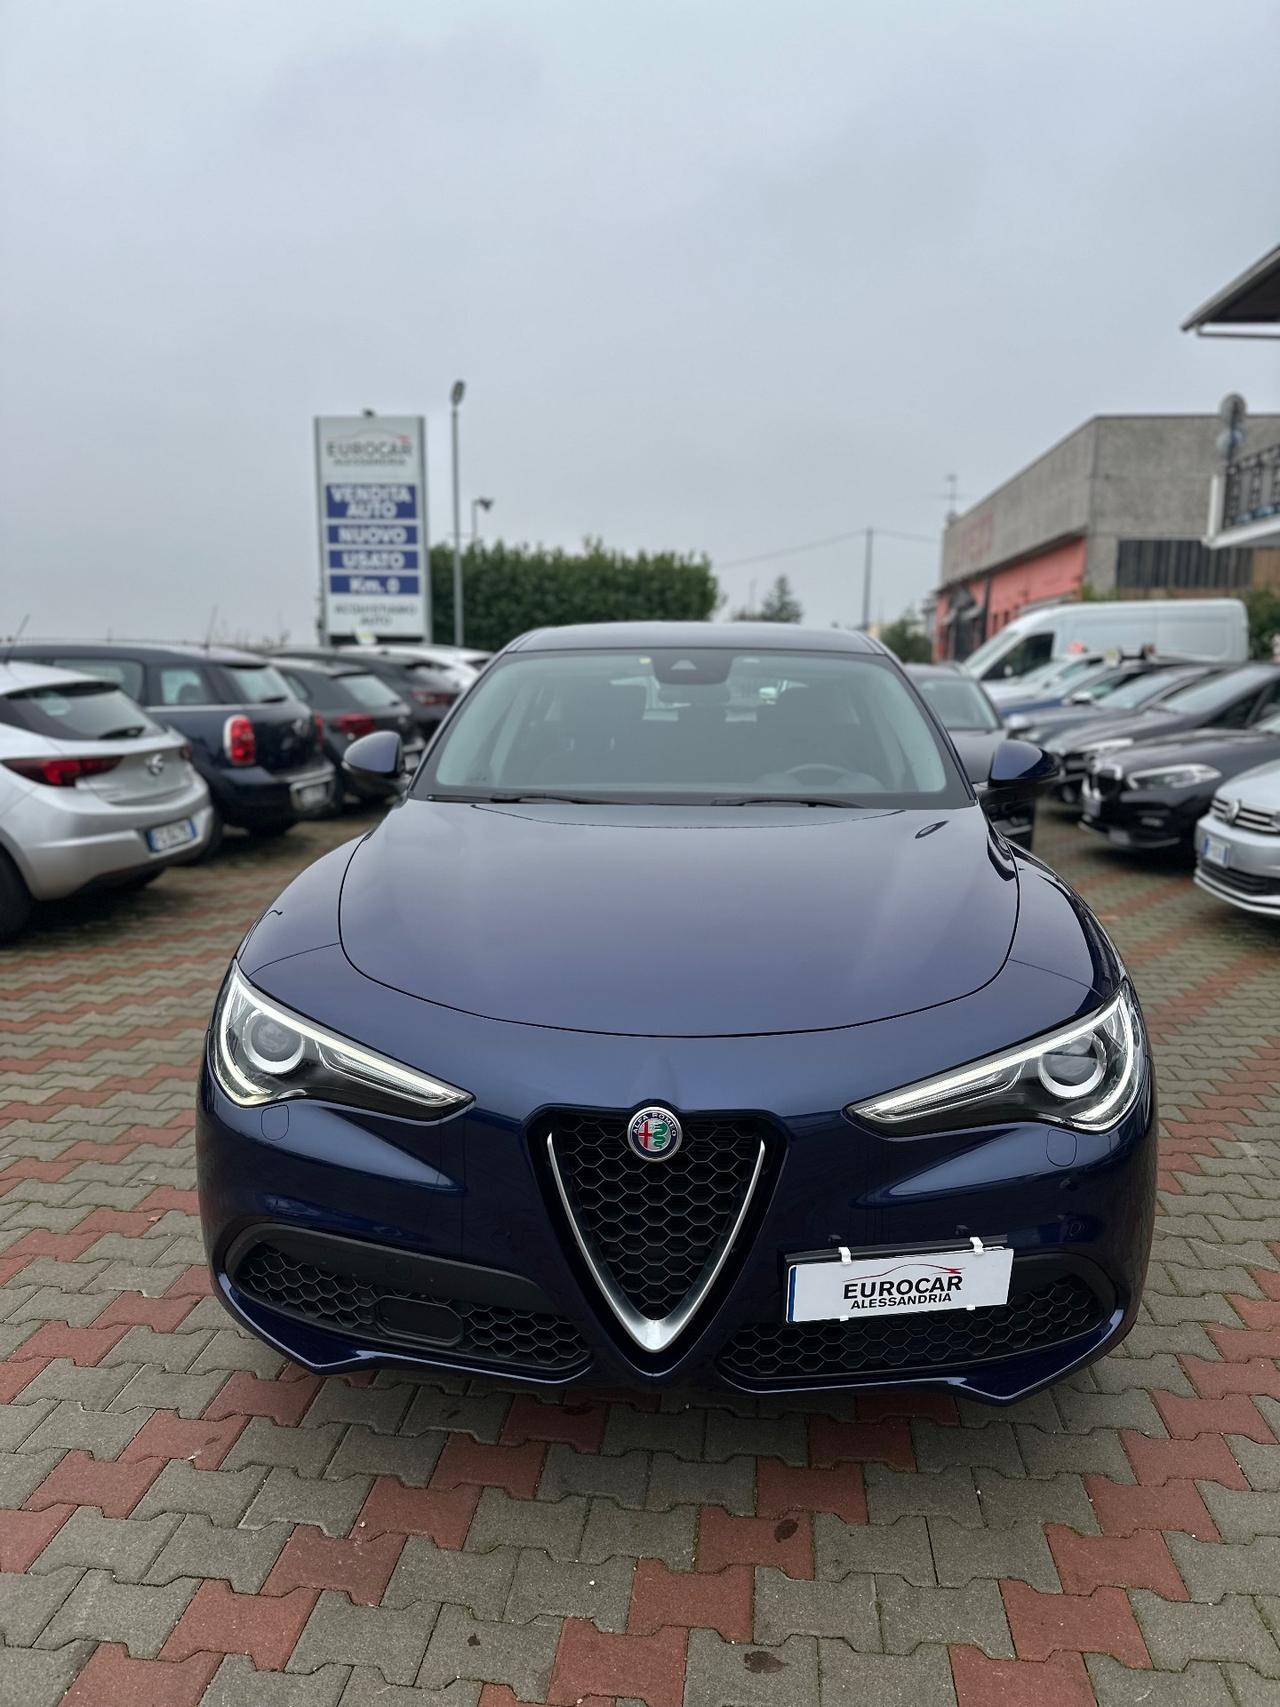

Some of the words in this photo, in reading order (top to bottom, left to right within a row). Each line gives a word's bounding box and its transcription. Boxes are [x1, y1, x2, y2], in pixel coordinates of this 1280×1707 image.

[327, 441, 412, 457] EUROCAR
[331, 487, 412, 503] VENDITA
[346, 503, 398, 518] AUTO
[338, 527, 408, 543] NUOVO
[342, 552, 405, 569] USATO
[350, 578, 386, 594] Km.
[387, 577, 400, 594] 0
[361, 617, 393, 626] AUTO
[633, 1114, 649, 1134] ALFA
[651, 1112, 677, 1137] ROMEO
[843, 1275, 963, 1299] EUROCAR
[851, 1293, 952, 1309] ALESSANDRIA
